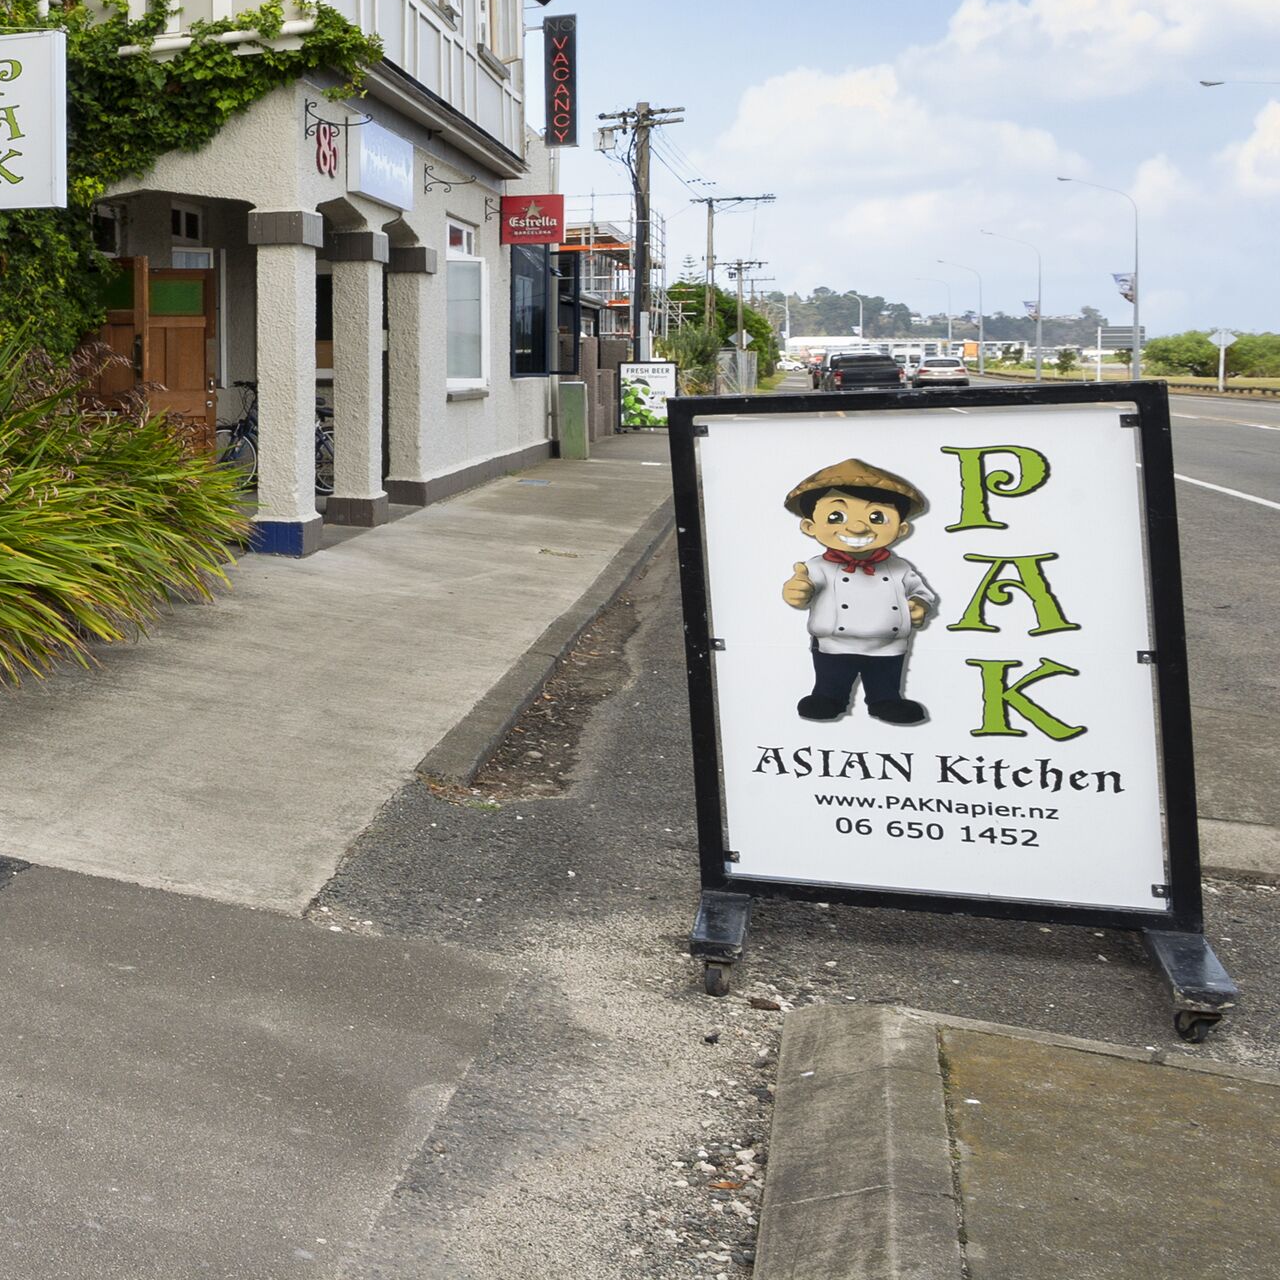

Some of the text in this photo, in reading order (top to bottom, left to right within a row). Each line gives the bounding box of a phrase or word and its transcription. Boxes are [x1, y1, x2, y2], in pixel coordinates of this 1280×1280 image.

[545, 18, 576, 32] NO
[552, 35, 571, 143] VACANCY
[509, 215, 558, 227] Estrella
[626, 367, 670, 375] FRESH BEER
[940, 445, 1088, 741] PAK
[752, 744, 1126, 794] ASIAN Kitchen
[814, 793, 1060, 821] www.PAKNapier.nz
[835, 816, 1040, 847] 06 650 1452
